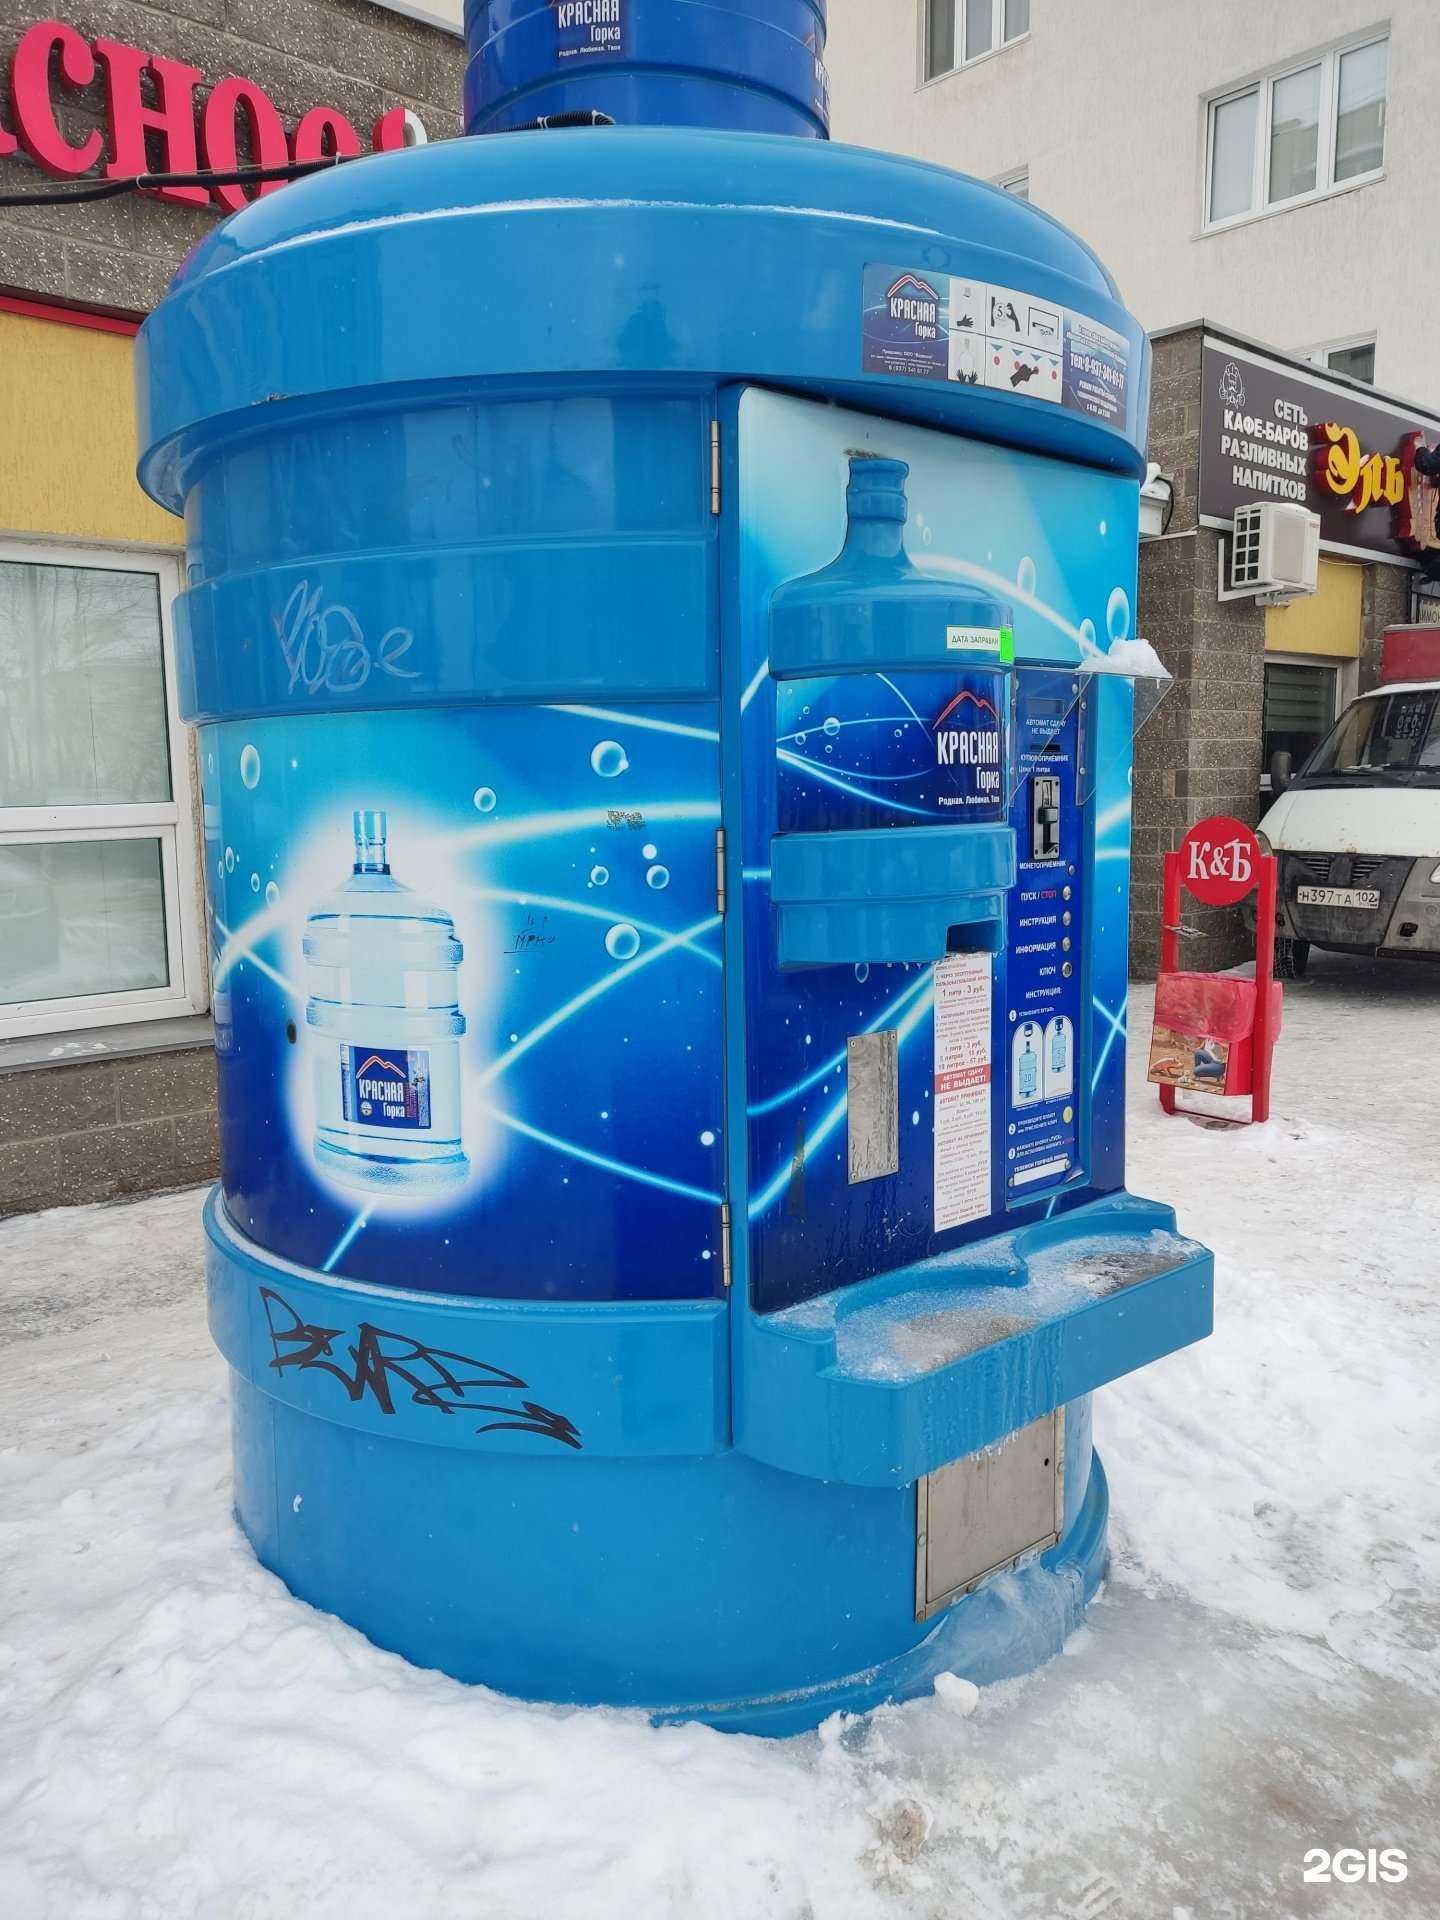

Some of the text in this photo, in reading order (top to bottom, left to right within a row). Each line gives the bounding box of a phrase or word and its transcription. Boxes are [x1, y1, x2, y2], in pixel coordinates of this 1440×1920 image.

[558, 0, 620, 29] КРАСНАЯ
[590, 25, 621, 44] Горка
[890, 297, 936, 323] КРАСНАЯ
[915, 321, 936, 340] Горка
[1273, 398, 1308, 426] СЕТЬ
[1223, 409, 1309, 451] КАФЕ-БАРОВ
[1221, 435, 1307, 477] РАЗЛИВНЫХ
[1232, 465, 1307, 501] НАПИТКОВ
[951, 635, 969, 643] ДАТА
[1026, 719, 1049, 727] АВТОМАТ
[1031, 727, 1039, 735] НЕ
[937, 731, 999, 765] КРАСНАЯ
[976, 767, 1000, 793] Горка
[938, 797, 965, 806] Родная.
[1187, 838, 1251, 882] К&Б
[1020, 891, 1036, 901] ПУСК
[1041, 890, 1057, 899] СТОП
[1302, 889, 1376, 904] Н397ТА 102
[1019, 915, 1057, 927] ИНСТРУКЦИЯ
[1015, 941, 1057, 955] ИНФОРМАЦИЯ
[1039, 966, 1056, 977] КЛЮЧ
[967, 985, 972, 994] 3
[1025, 986, 1063, 999] ИНСТРУКЦИЯ:
[359, 1079, 404, 1102] КРАСНАЯ
[940, 1074, 986, 1092] НЕ ВЫДАЕТ!
[383, 1102, 405, 1119] Горка
